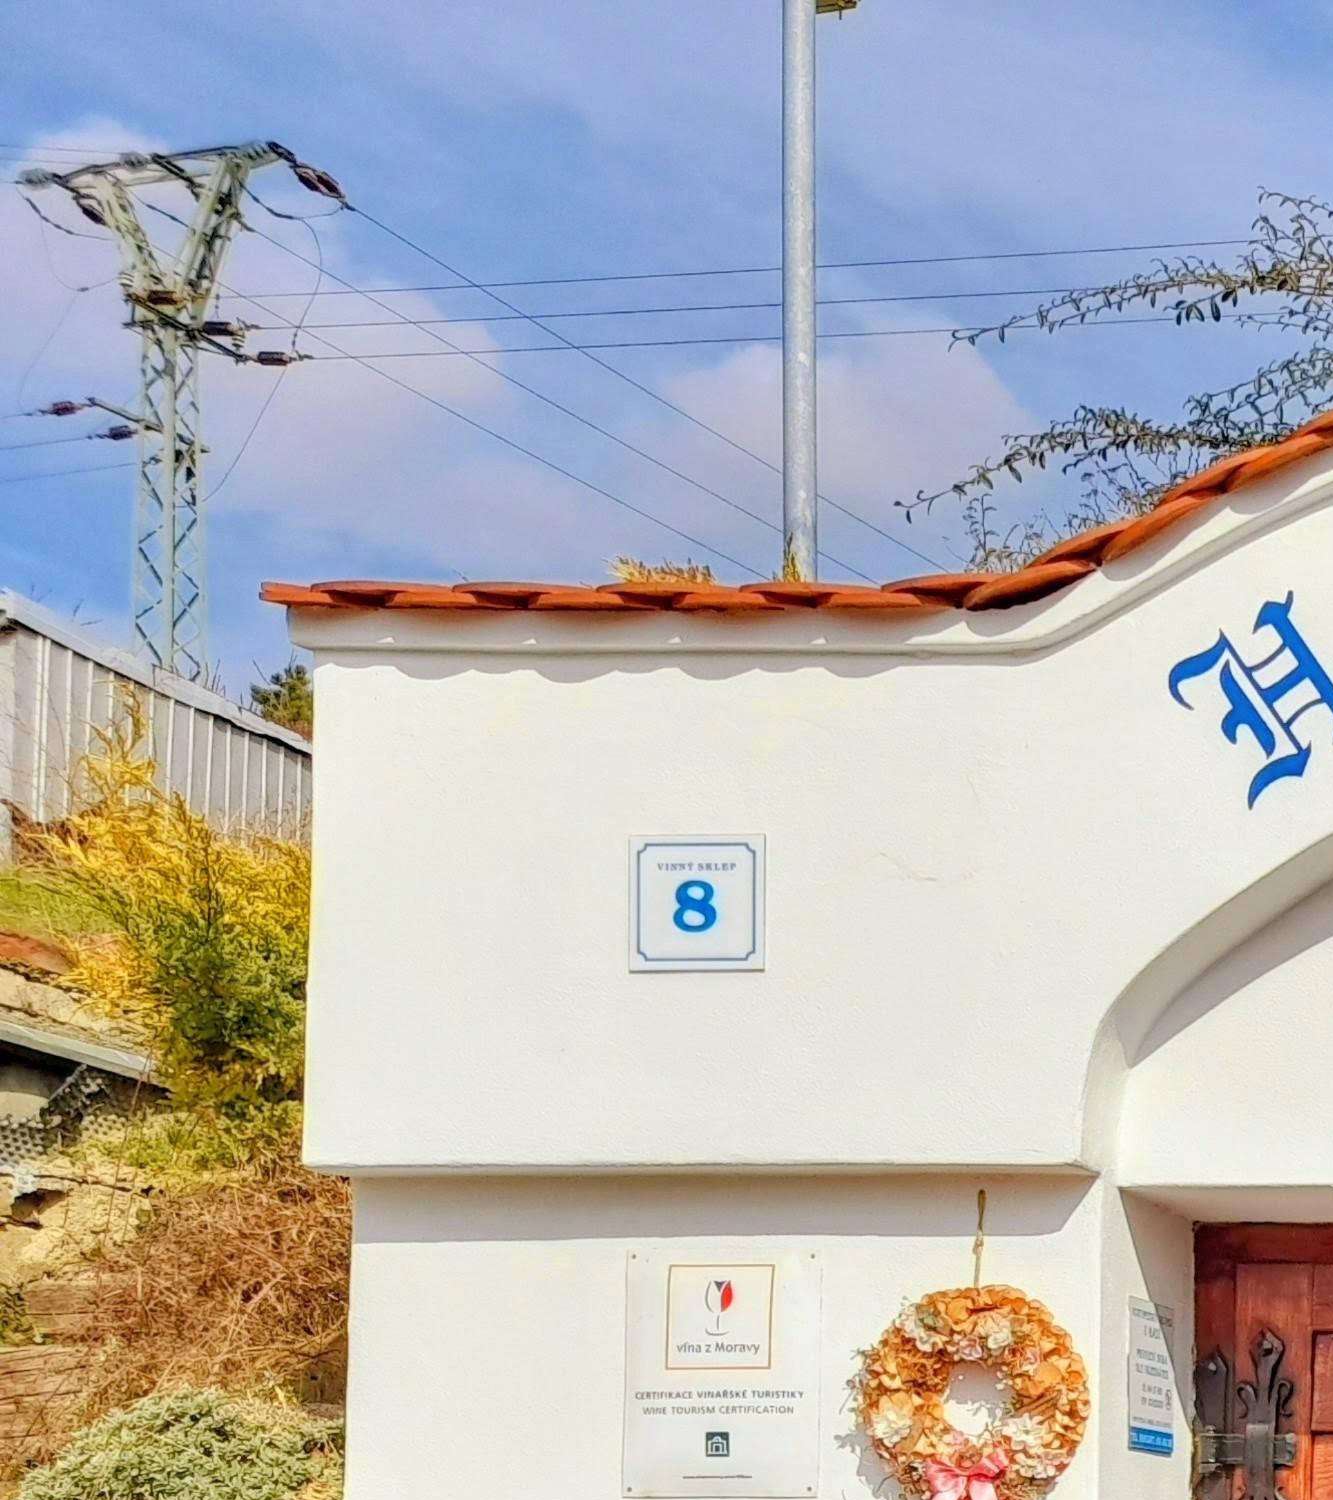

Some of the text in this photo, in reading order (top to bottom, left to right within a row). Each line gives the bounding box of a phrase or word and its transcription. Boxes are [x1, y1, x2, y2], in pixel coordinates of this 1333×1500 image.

[657, 861, 737, 872] VINNÝ SKLEP
[673, 880, 717, 933] 8
[676, 1341, 760, 1355] vína z Moravy
[635, 1389, 804, 1400] CERTIFIKACE VINAŘSKÉ TURISTIKY
[642, 1405, 794, 1415] WINE TOURISM CERTIFICATION
